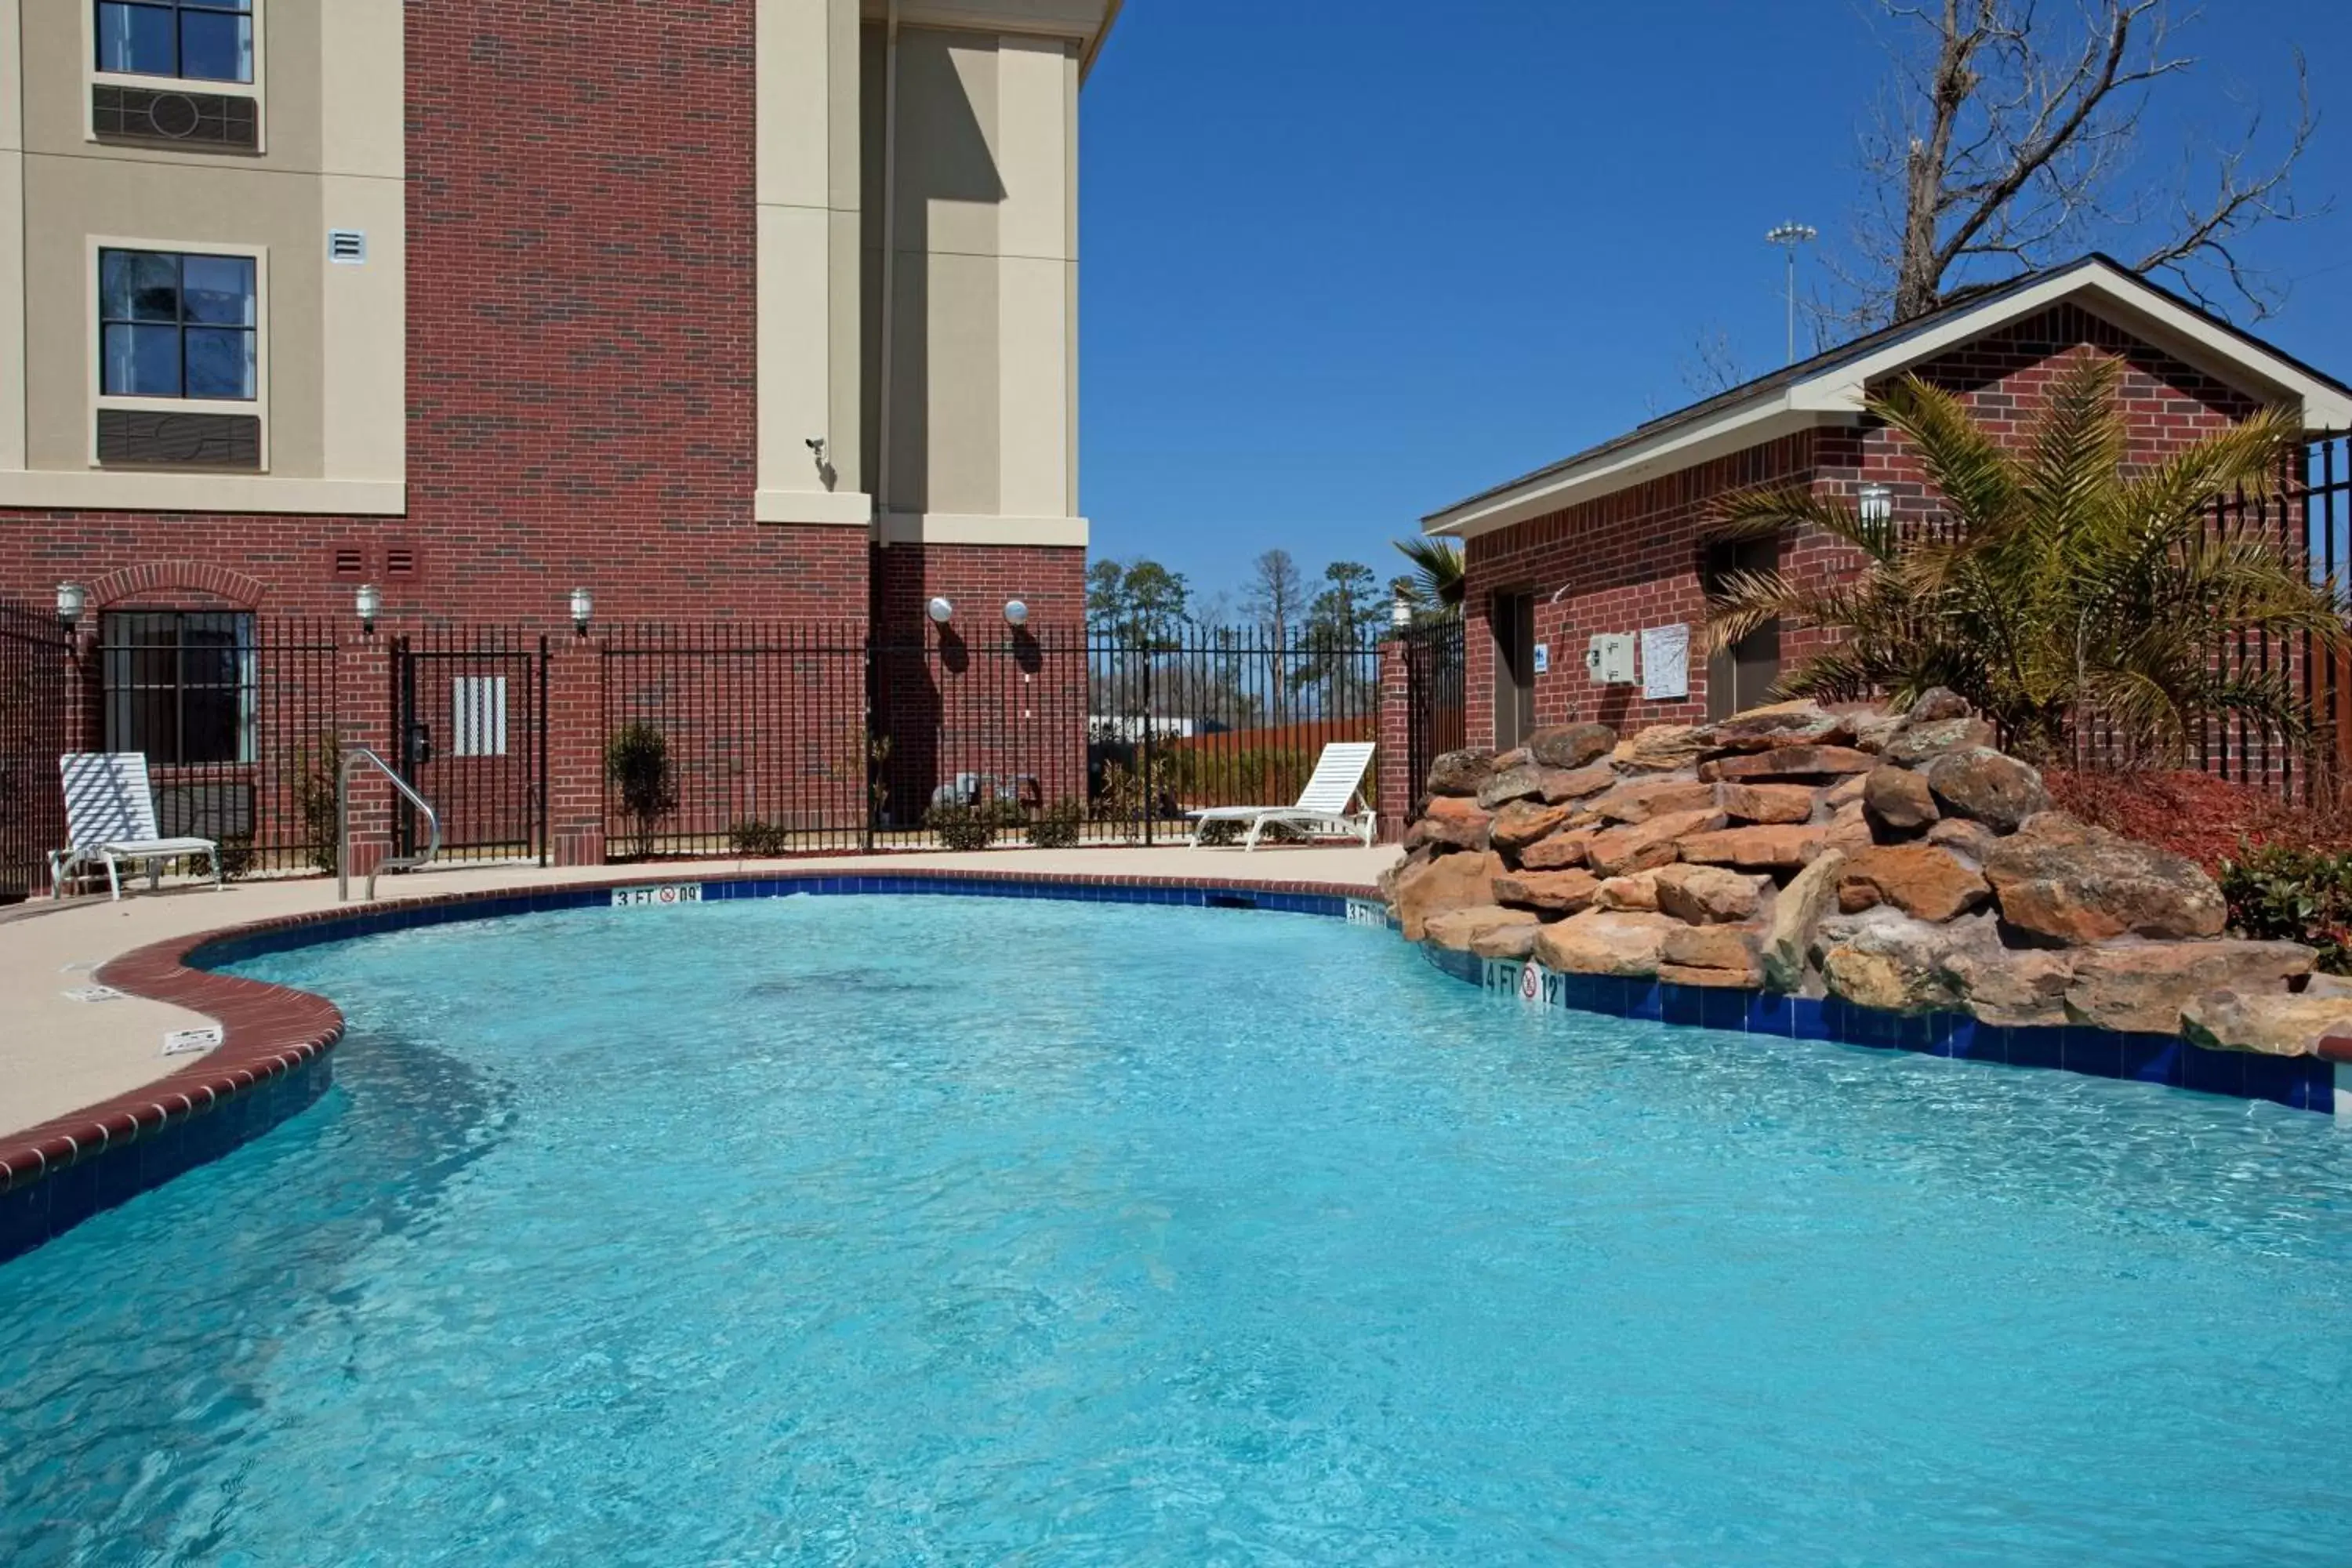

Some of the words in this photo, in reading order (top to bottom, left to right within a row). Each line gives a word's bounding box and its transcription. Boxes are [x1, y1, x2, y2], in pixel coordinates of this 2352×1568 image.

[618, 891, 628, 906] 3
[636, 888, 654, 904] FT
[1486, 963, 1494, 992] 4
[1500, 964, 1517, 996] FT
